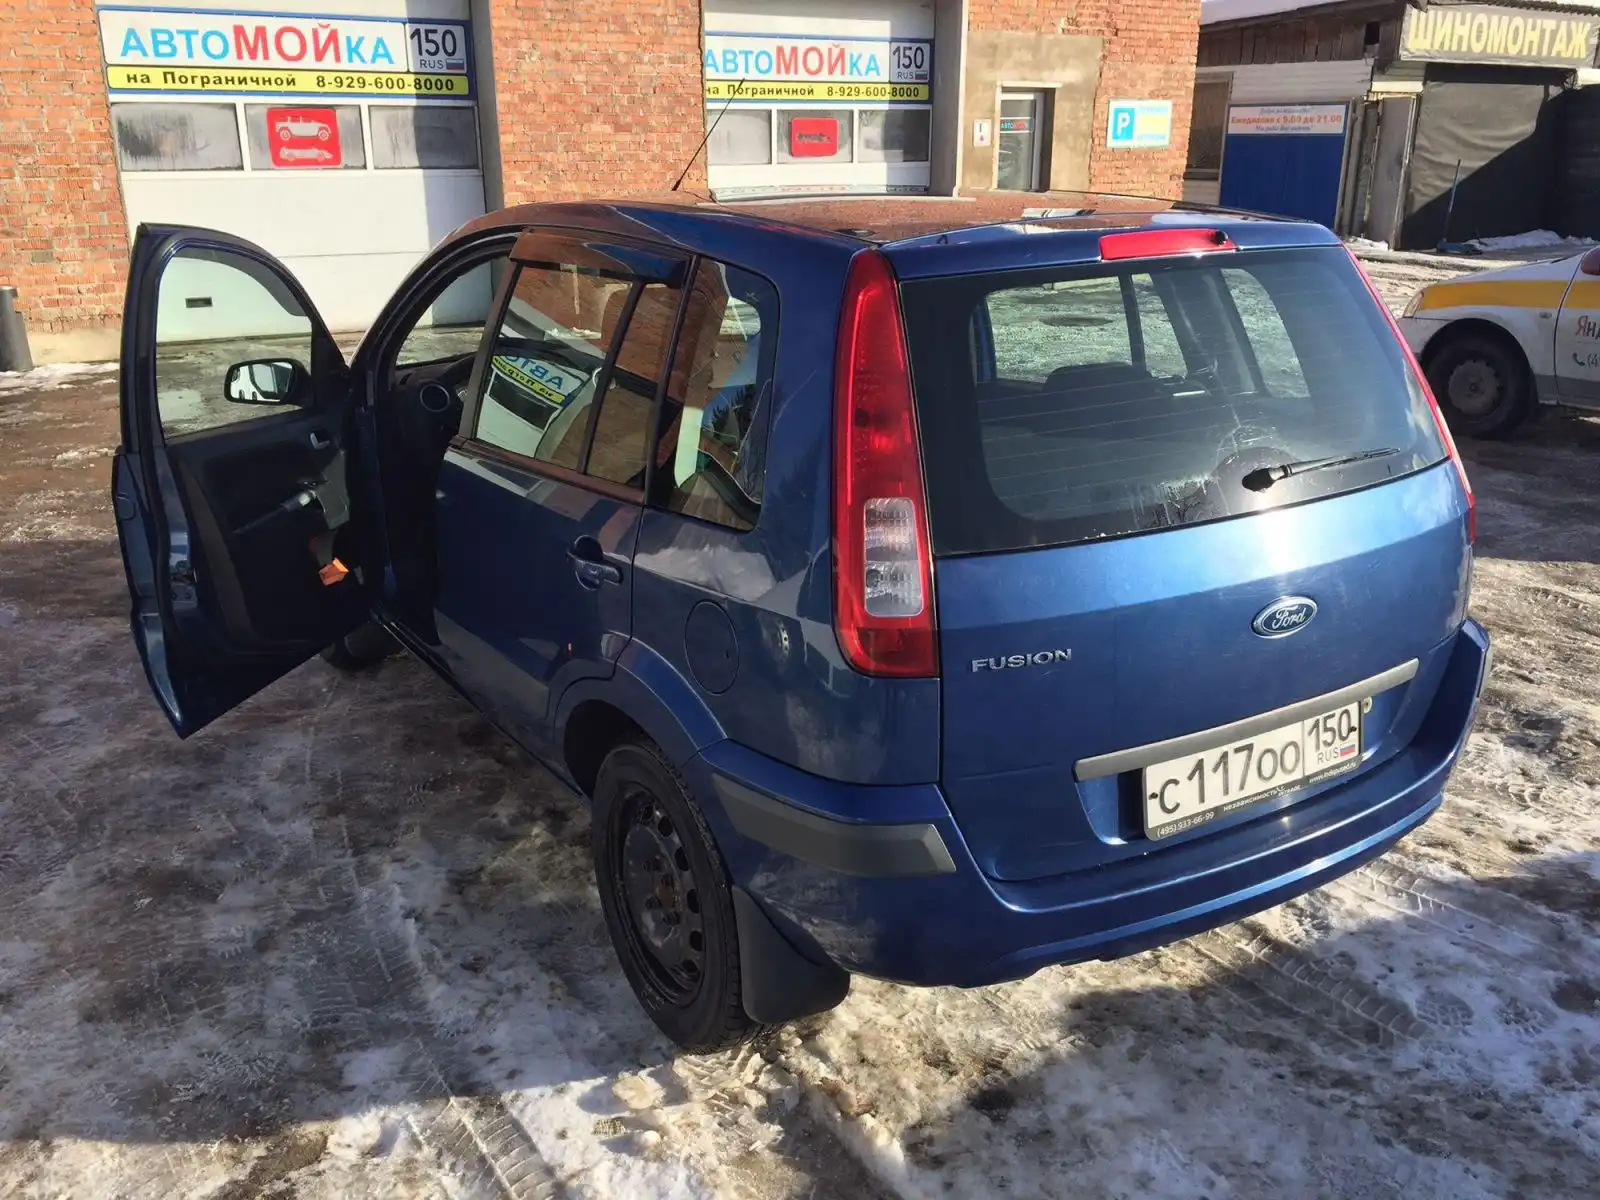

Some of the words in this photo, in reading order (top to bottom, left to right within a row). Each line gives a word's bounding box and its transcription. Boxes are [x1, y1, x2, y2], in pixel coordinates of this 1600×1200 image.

[409, 27, 457, 58] 150
[1407, 9, 1591, 59] ШИНОМОНТАЖ
[419, 58, 444, 70] RUS
[892, 45, 925, 70] 150
[126, 72, 151, 84] на
[163, 70, 297, 88] Пограничной
[316, 75, 455, 92] 8-929-600-8000
[896, 71, 914, 80] RUS
[727, 83, 814, 98] Пограничной
[826, 85, 920, 98] 8-929-600-8000
[1272, 604, 1306, 629] Ford
[971, 648, 1072, 673] FUSION
[1307, 708, 1352, 751] 150
[1317, 747, 1340, 766] RUS
